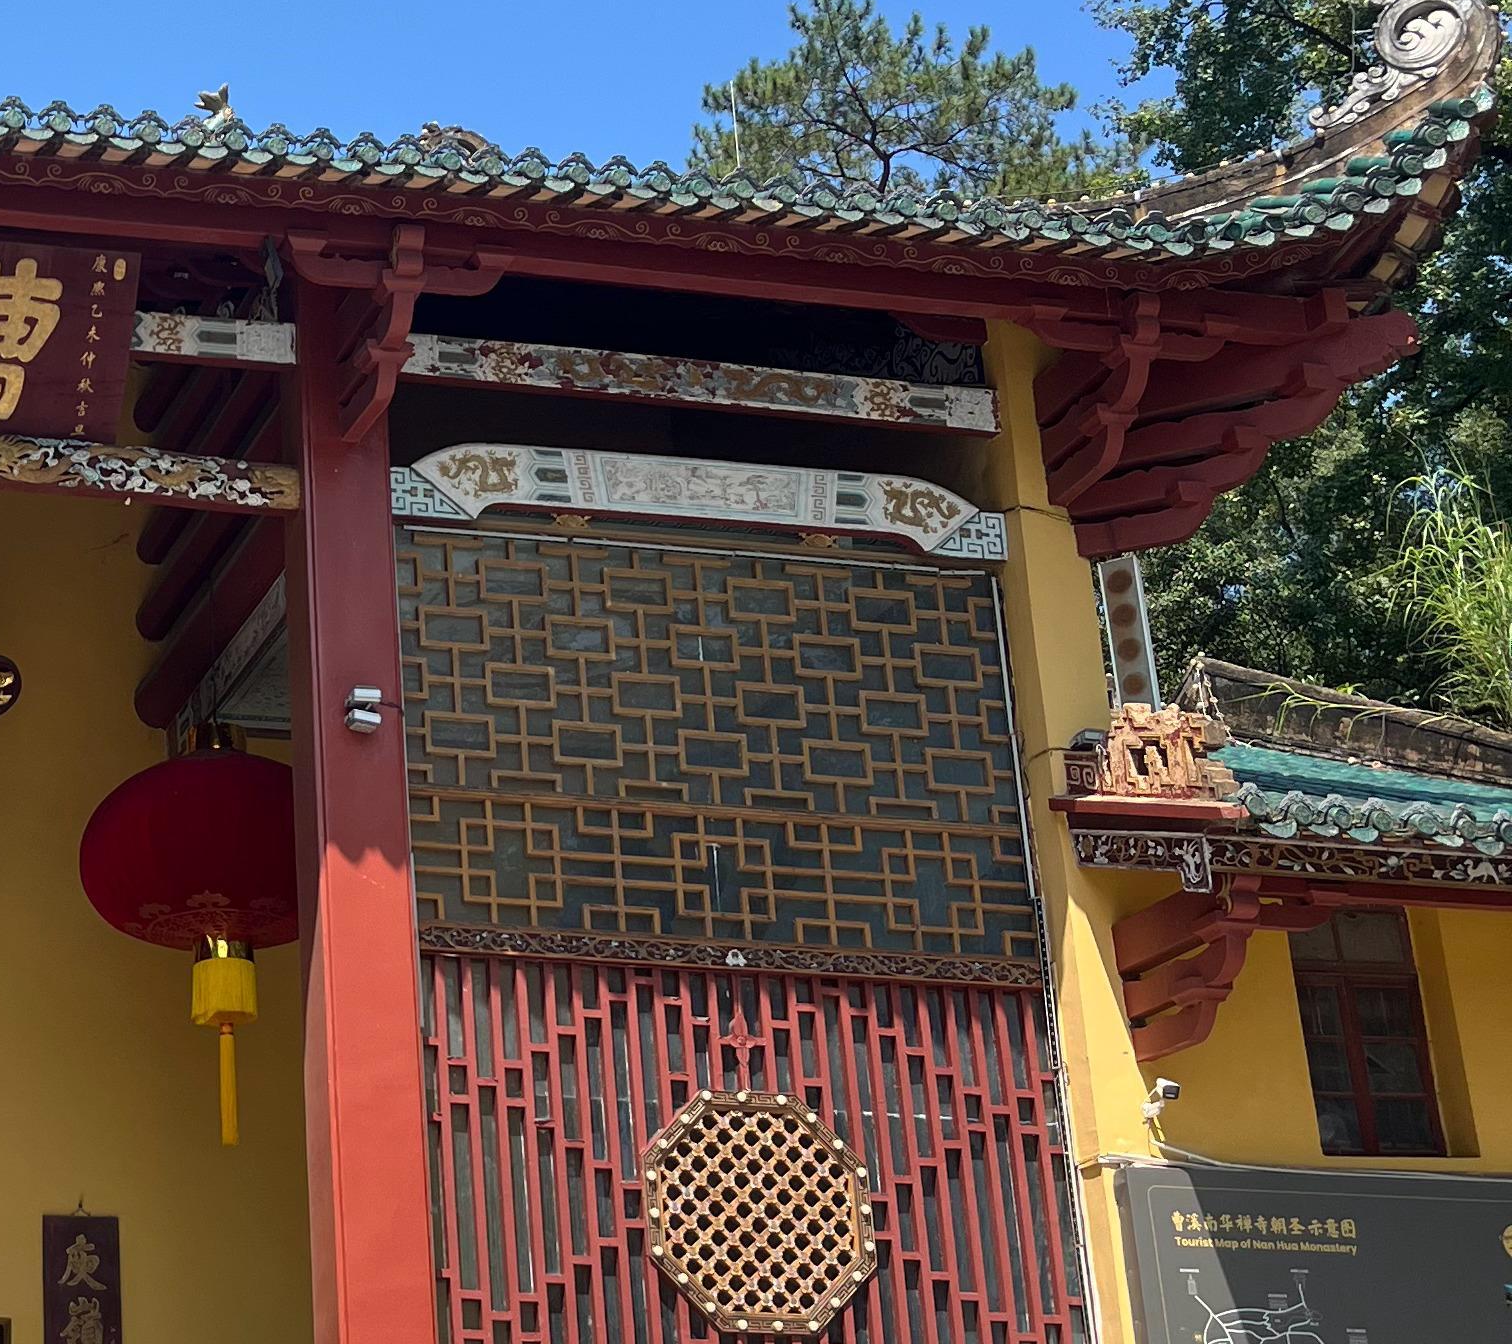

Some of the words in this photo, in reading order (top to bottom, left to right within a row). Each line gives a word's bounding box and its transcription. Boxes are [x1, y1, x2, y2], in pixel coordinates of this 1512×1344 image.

[1174, 1236, 1213, 1248] Tourist
[1215, 1238, 1238, 1251] Map
[1240, 1238, 1251, 1249] of
[1253, 1239, 1275, 1250] Nan
[1277, 1241, 1299, 1251] Hua
[1300, 1242, 1357, 1256] Monastery
